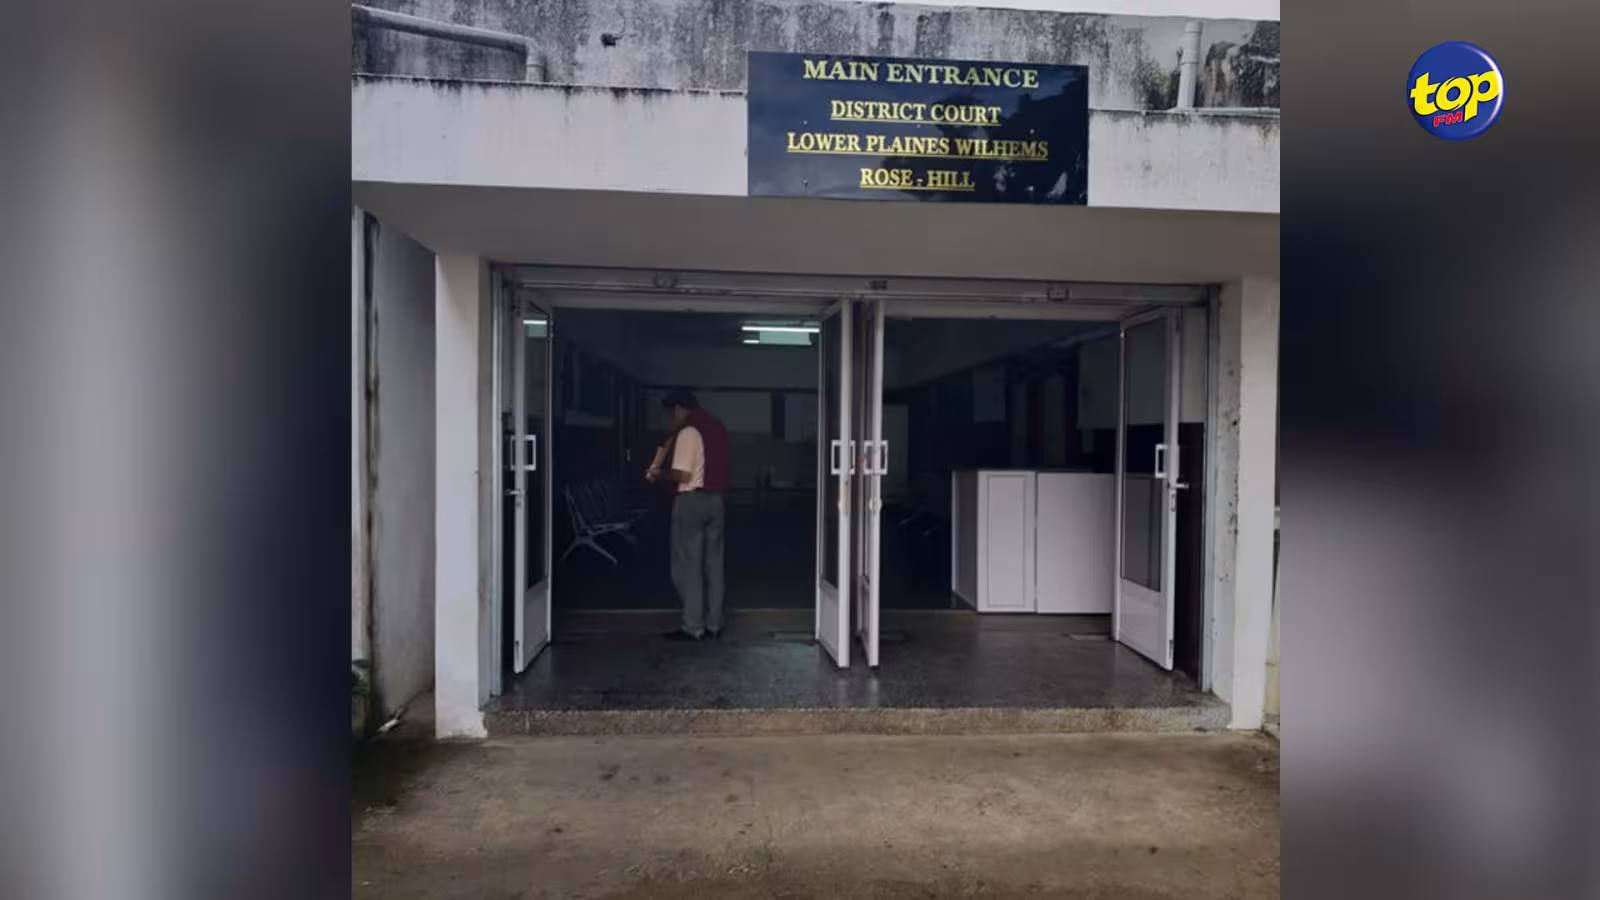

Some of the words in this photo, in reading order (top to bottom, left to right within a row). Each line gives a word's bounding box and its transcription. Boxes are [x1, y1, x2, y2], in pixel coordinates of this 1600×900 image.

[803, 59, 879, 81] MAIN
[887, 63, 1039, 88] ENTRANCE
[831, 99, 926, 120] DISTRICT
[930, 103, 1001, 123] COURT
[787, 132, 861, 152] LOWER
[866, 135, 950, 155] PLAINES
[955, 138, 1048, 158] WILHEMS
[860, 168, 912, 187] ROSE
[927, 170, 975, 188] HILL
